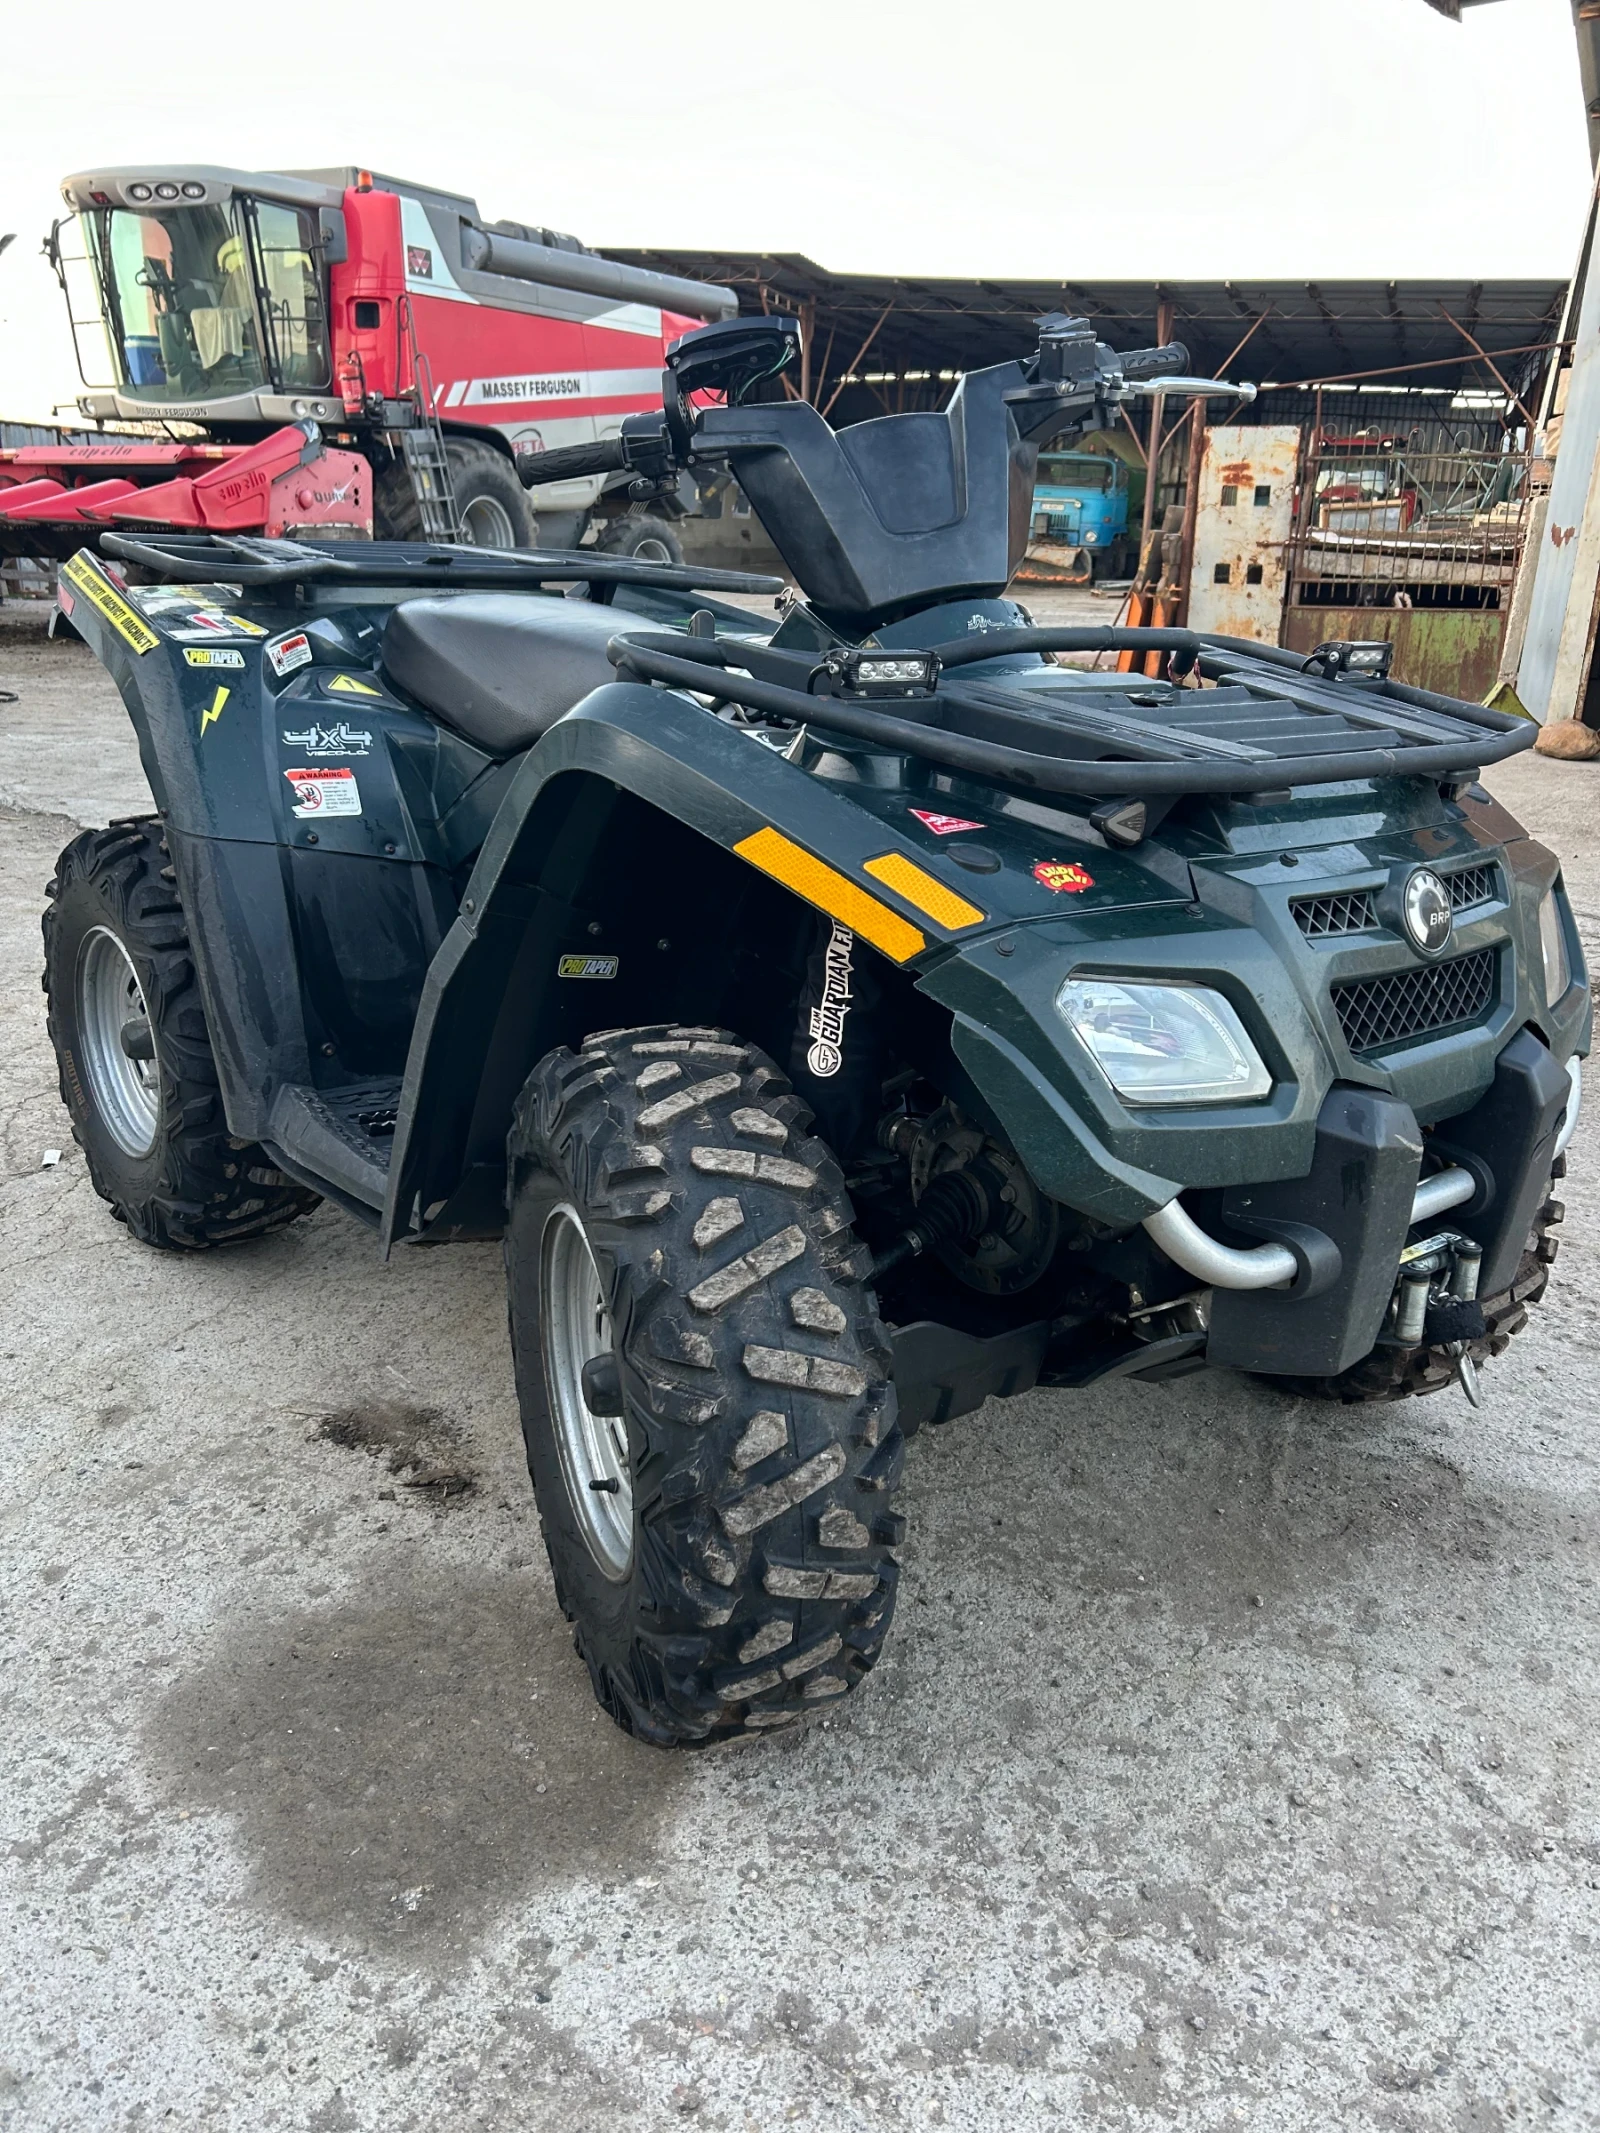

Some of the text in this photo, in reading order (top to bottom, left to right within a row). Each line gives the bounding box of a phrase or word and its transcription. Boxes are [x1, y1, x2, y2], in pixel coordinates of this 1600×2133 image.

[482, 378, 581, 399] MASSEY FERGUSON
[164, 407, 209, 418] FERGUSON
[306, 771, 343, 779] WARNING
[1430, 910, 1450, 926] BRP
[820, 950, 850, 1045] GUARDIAN
[811, 1011, 821, 1035] TEAM
[64, 1049, 86, 1107] BULLDOG
